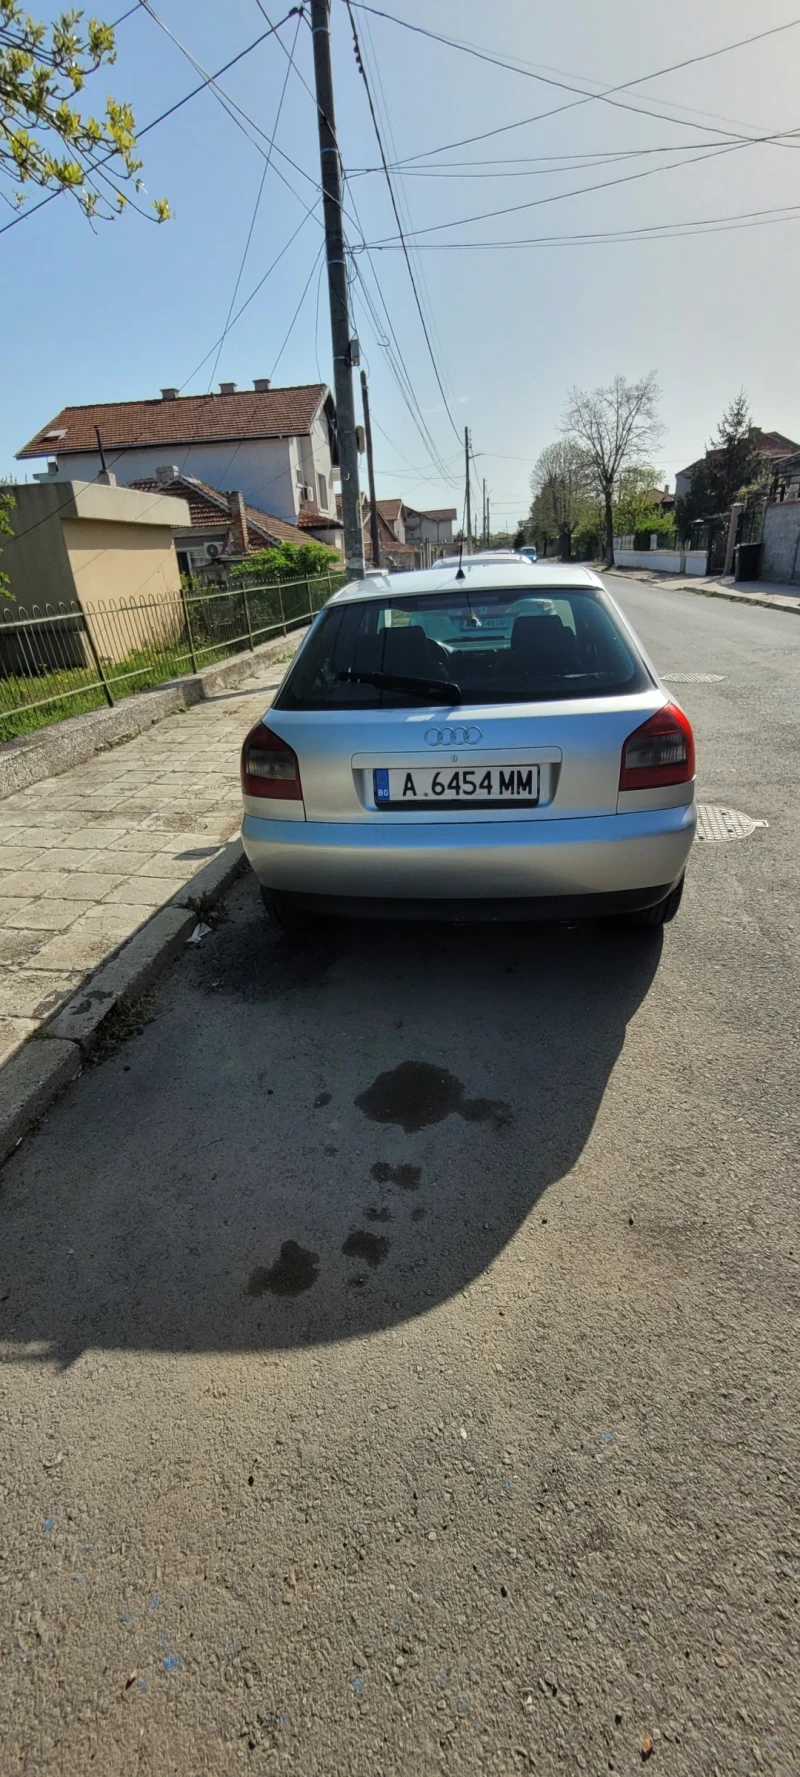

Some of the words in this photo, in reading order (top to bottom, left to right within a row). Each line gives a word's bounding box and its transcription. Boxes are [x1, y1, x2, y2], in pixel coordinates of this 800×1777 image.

[402, 772, 417, 797] A
[431, 771, 493, 796] 6454
[499, 770, 533, 795] MM
[378, 789, 389, 797] BG
